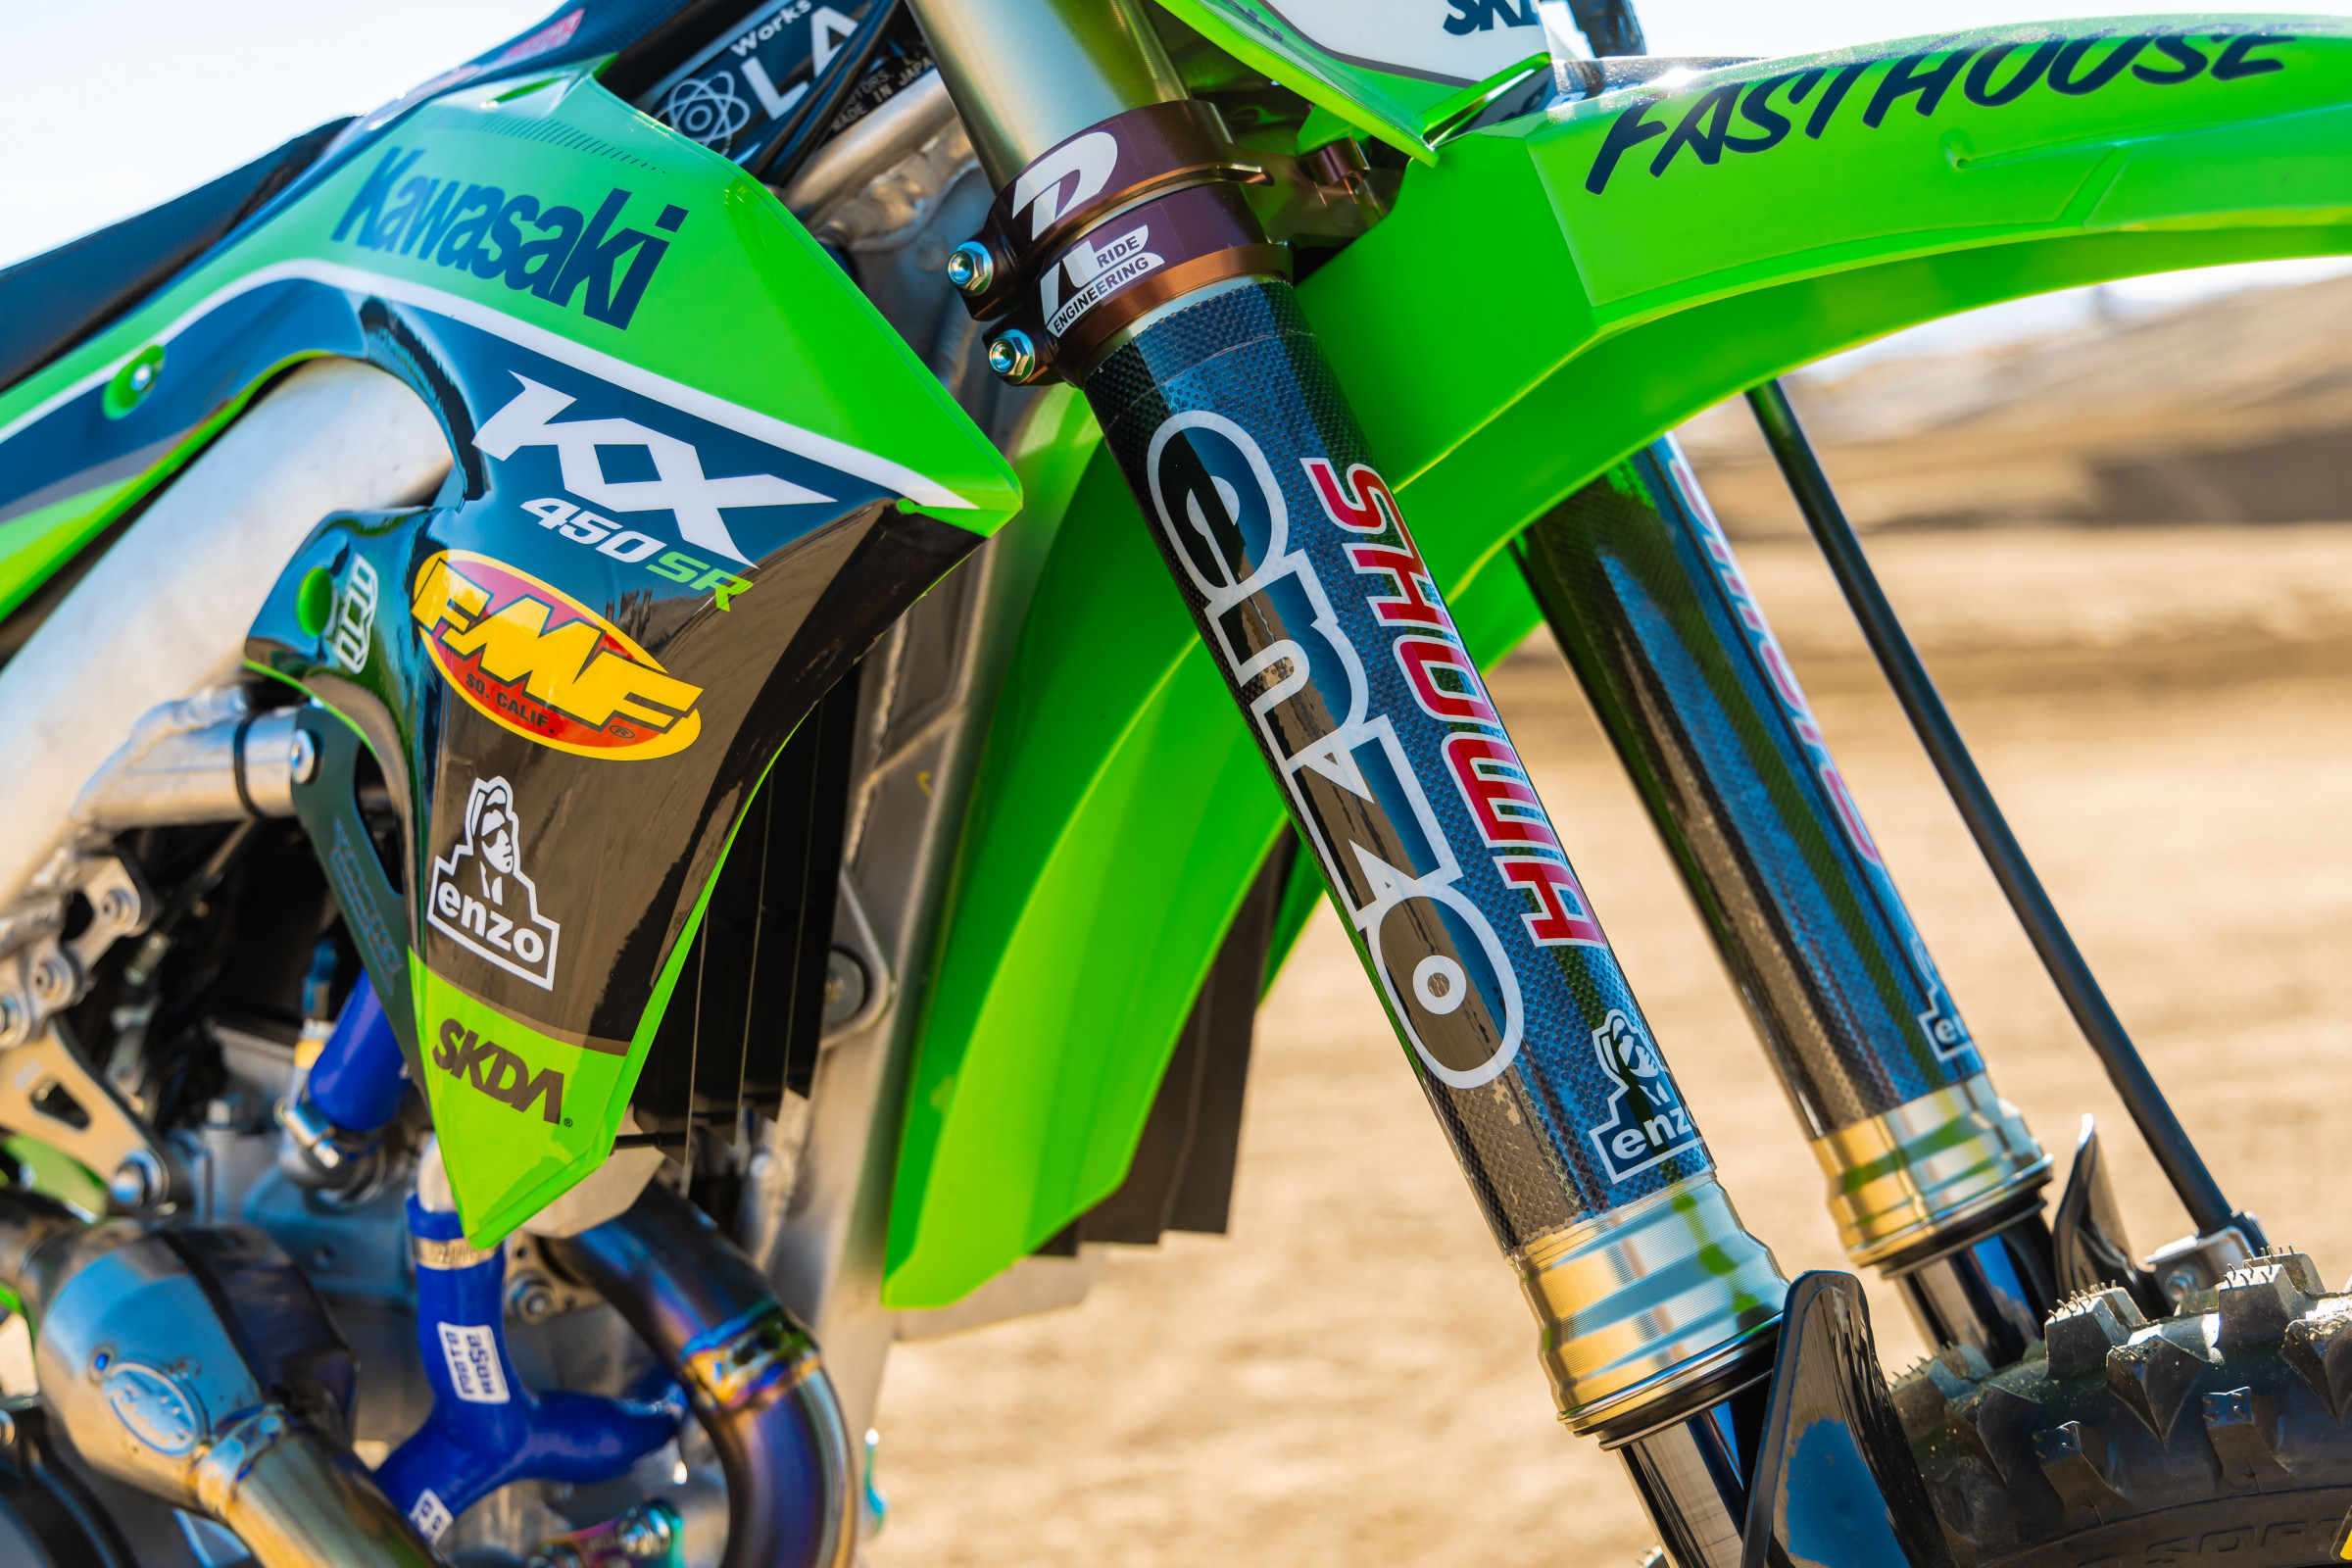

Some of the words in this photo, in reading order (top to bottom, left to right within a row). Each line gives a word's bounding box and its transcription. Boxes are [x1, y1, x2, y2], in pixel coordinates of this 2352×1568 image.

[729, 0, 812, 57] Works
[872, 83, 893, 103] IN
[898, 56, 935, 86] JAPA
[1584, 23, 2344, 195] FASTHOUSE
[330, 146, 690, 331] Kawasaki
[1053, 256, 1150, 334] ENGINEERING
[1095, 235, 1141, 269] RIDE
[470, 368, 839, 570] KX
[411, 557, 705, 733] FMF
[464, 672, 491, 700] SO.
[495, 691, 556, 734] CALIF.
[1299, 457, 1609, 949] SHOWA
[1147, 410, 1525, 1090] enzo
[437, 879, 545, 964] enzo
